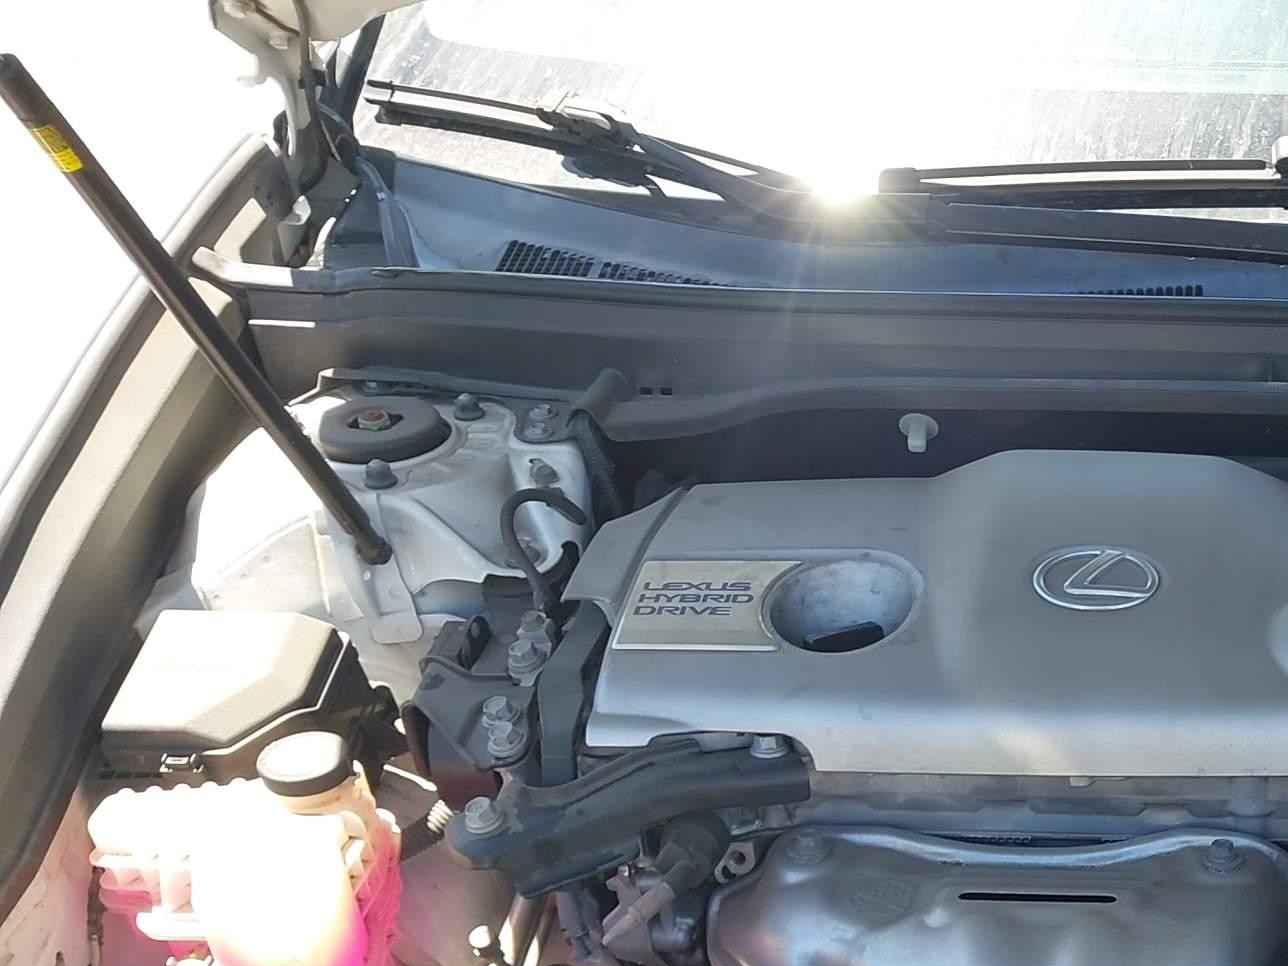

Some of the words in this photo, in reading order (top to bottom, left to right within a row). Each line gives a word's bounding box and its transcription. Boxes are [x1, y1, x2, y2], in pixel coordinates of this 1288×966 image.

[643, 582, 752, 591] LEXUS
[638, 594, 754, 604] HYBRID
[633, 606, 733, 616] DRIVE
